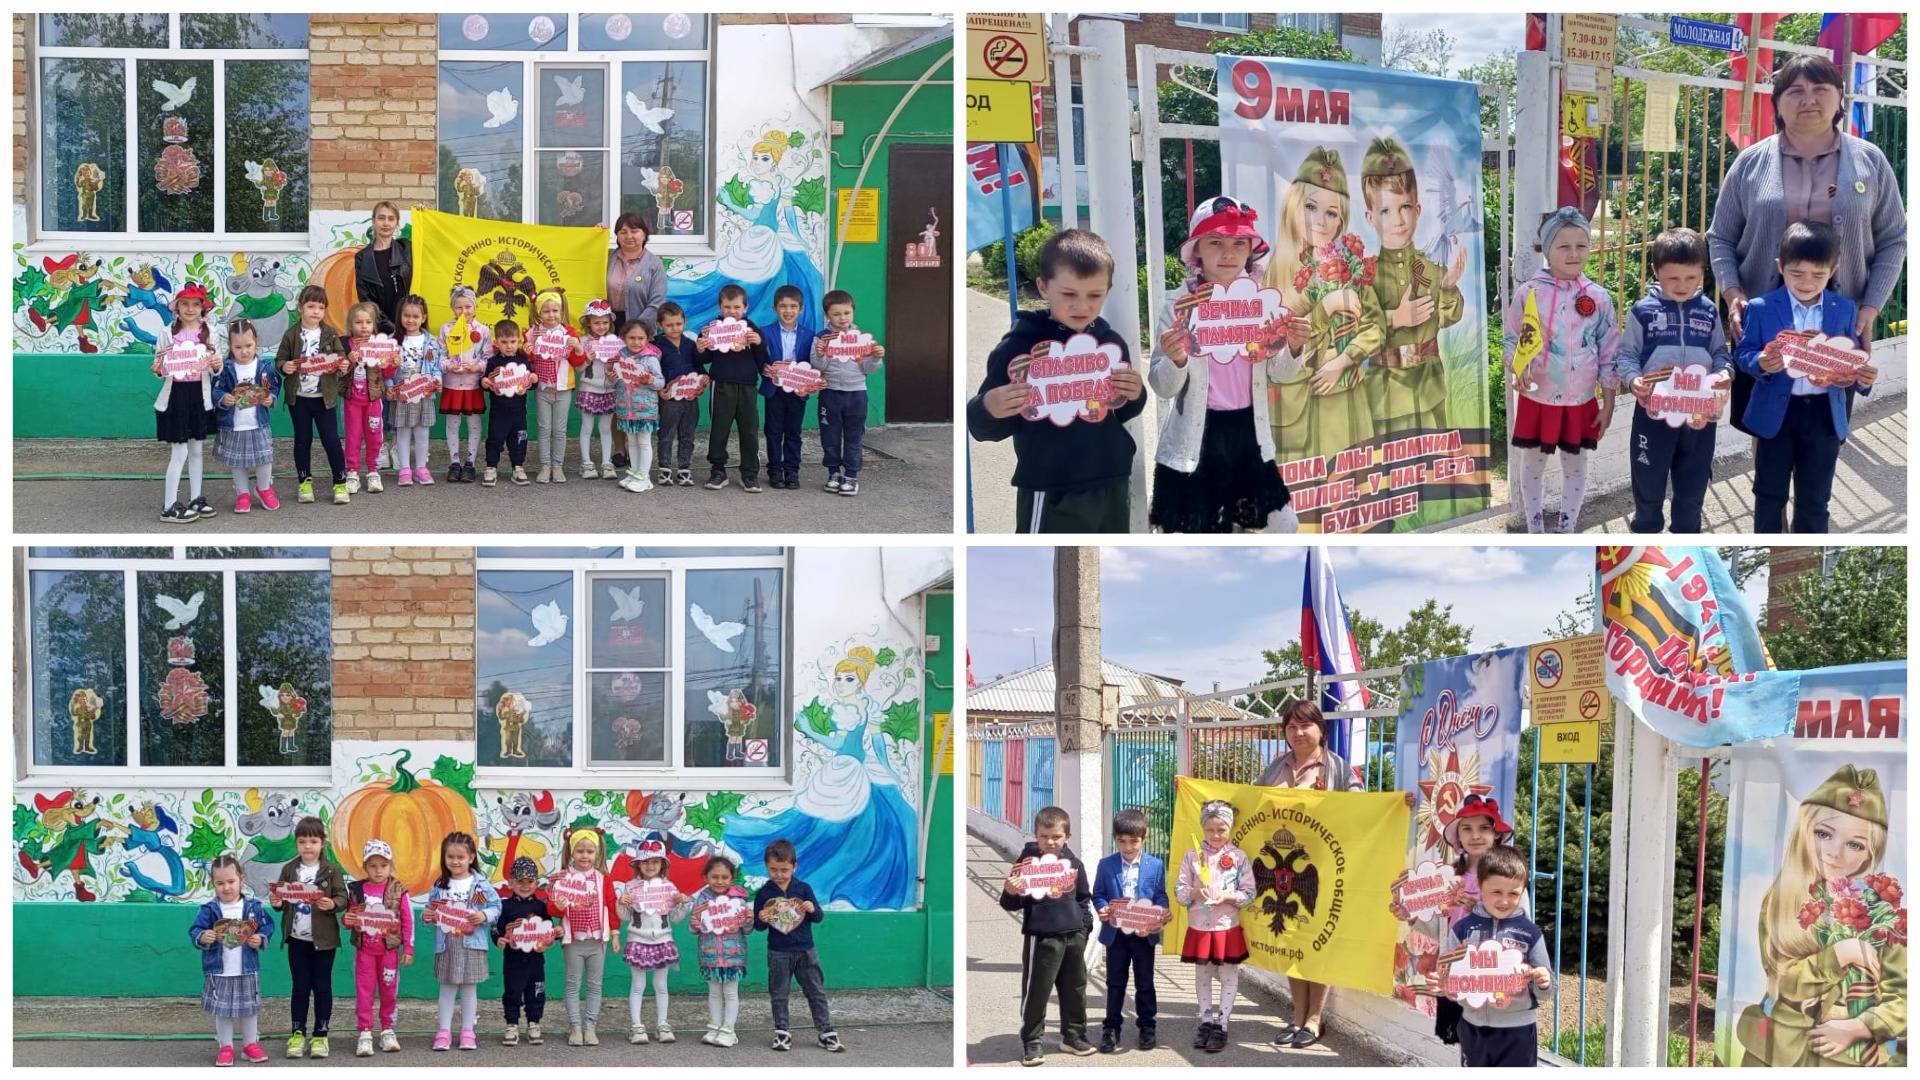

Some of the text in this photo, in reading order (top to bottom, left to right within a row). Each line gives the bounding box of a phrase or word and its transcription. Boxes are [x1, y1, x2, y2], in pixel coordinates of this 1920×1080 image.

[1673, 22, 1731, 46] МОЛОДЕЖНАЯ
[1232, 59, 1350, 126] 9 МАЯ
[1198, 299, 1263, 320] ВЕЧНАЯ
[1197, 324, 1265, 346] ПАМЯТЬ
[1029, 352, 1110, 378] СПАСИБО
[1674, 372, 1701, 391] МЫ
[1028, 385, 1045, 406] А
[1335, 446, 1374, 474] МЫ
[1382, 429, 1463, 464] ПОМНИМ
[1369, 472, 1383, 495] У
[1390, 463, 1427, 491] НАС
[1433, 455, 1476, 481] ЕСТЬ
[1321, 491, 1419, 534] БУДУЩЕЕ!
[1793, 697, 1900, 739] МАЯ
[1557, 732, 1580, 743] ВХОД
[1312, 878, 1344, 952] ОБЩЕСТВО
[1469, 949, 1498, 969] МЫ
